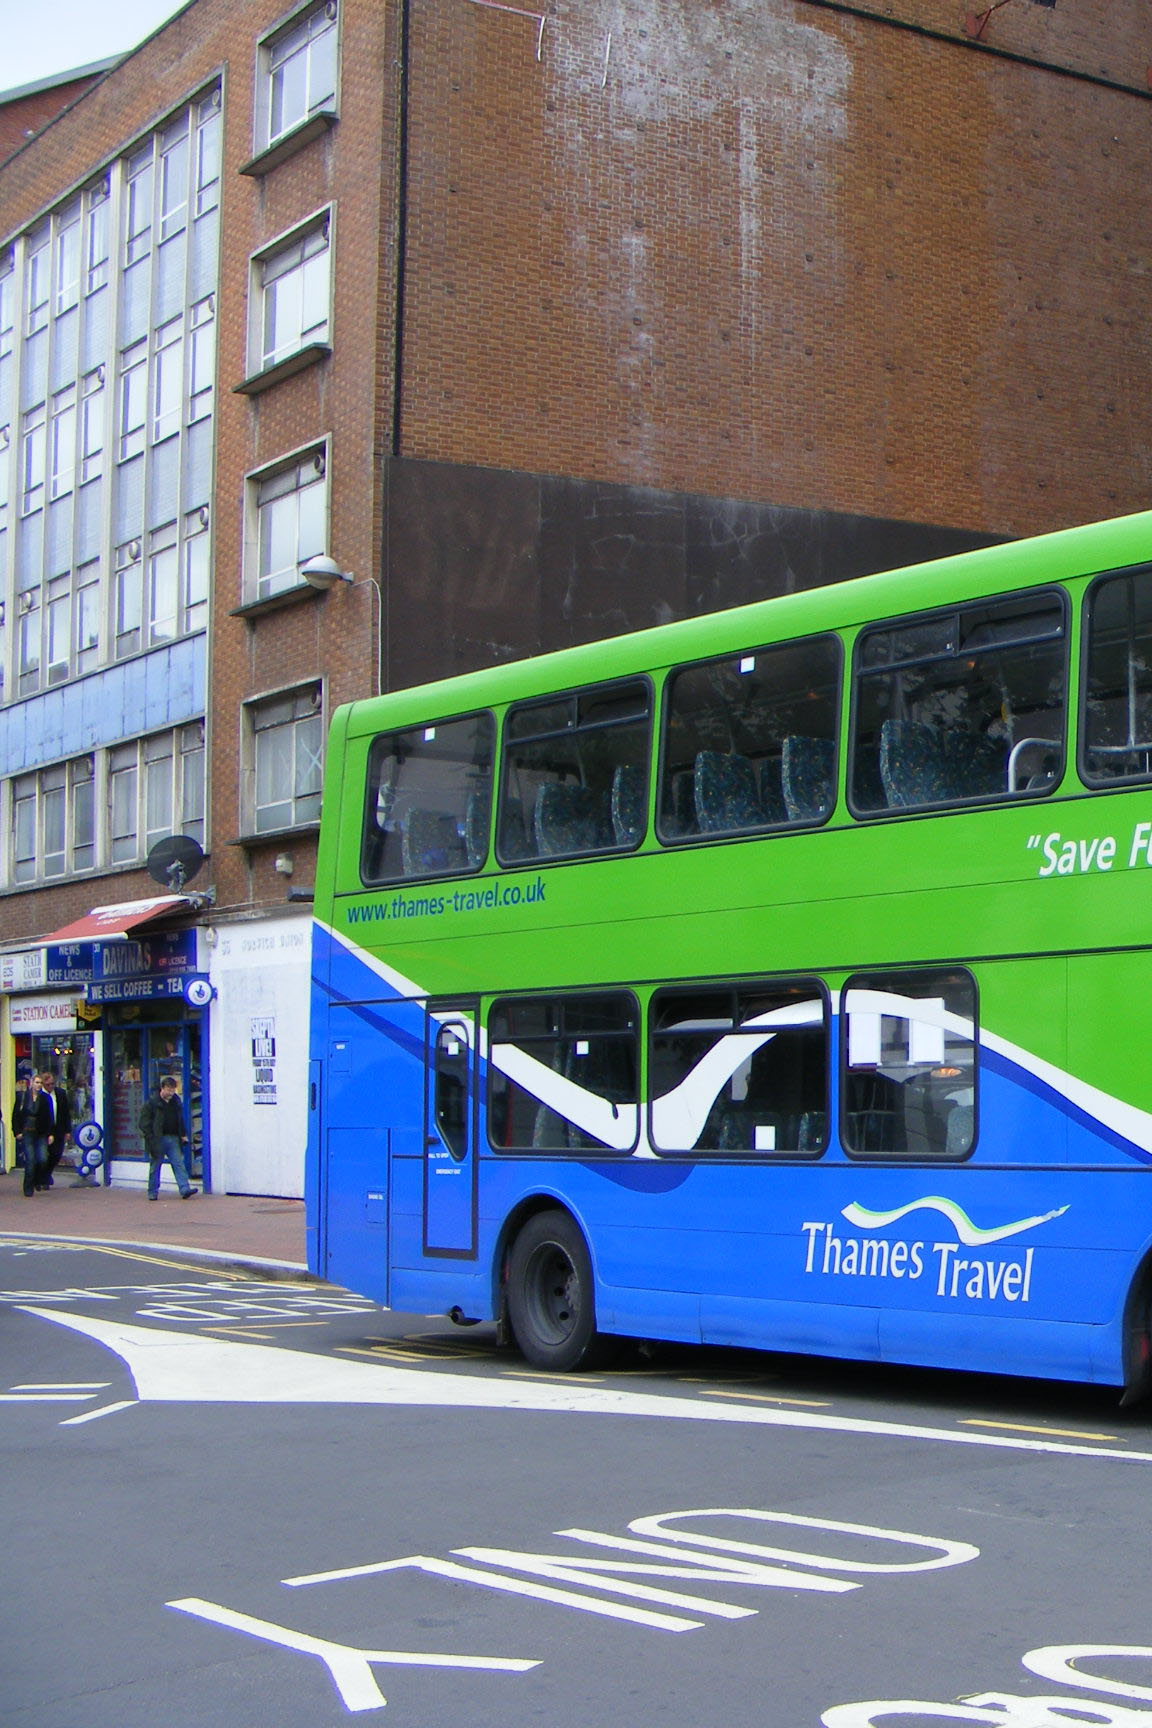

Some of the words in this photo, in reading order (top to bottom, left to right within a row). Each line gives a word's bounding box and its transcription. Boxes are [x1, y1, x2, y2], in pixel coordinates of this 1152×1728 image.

[1026, 832, 1117, 876] "Save
[346, 875, 546, 924] www.thames-travel.co.uk
[58, 943, 80, 956] NEWS
[102, 941, 152, 976] DAVINAS
[48, 969, 62, 982] OFF
[63, 967, 93, 982] LICENCE
[91, 985, 103, 1000] WE
[103, 983, 122, 999] SELL
[123, 980, 153, 997] COFFEE
[166, 976, 184, 993] TEA
[23, 1005, 48, 1021] STATION
[801, 1221, 924, 1280] Thames
[932, 1242, 1034, 1302] Travel
